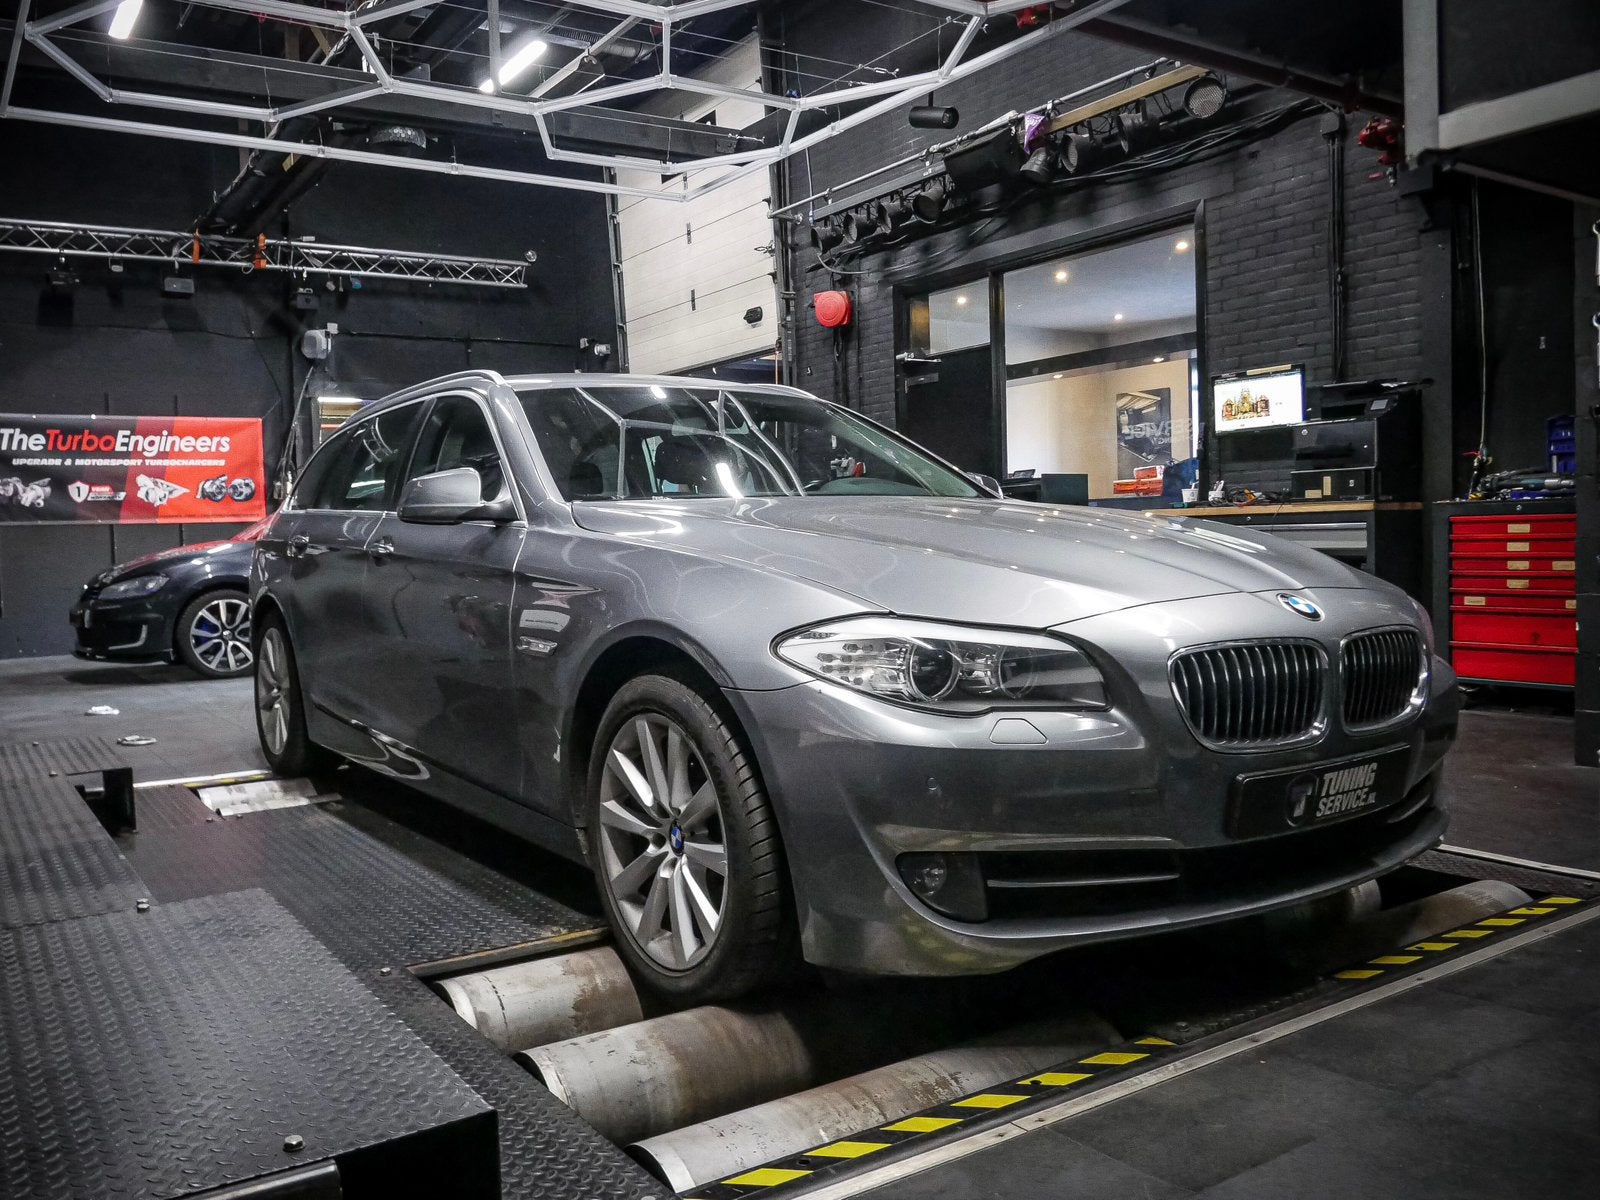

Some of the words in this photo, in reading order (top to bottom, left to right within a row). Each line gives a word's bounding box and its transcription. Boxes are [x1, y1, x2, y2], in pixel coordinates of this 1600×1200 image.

[0, 428, 230, 457] TheTurboEngineers
[12, 458, 62, 466] UPGRADE
[64, 458, 72, 466] &
[75, 458, 143, 467] MOTORSPORT
[145, 458, 226, 467] TURBOCHARGERS
[1320, 763, 1378, 797] TUNING
